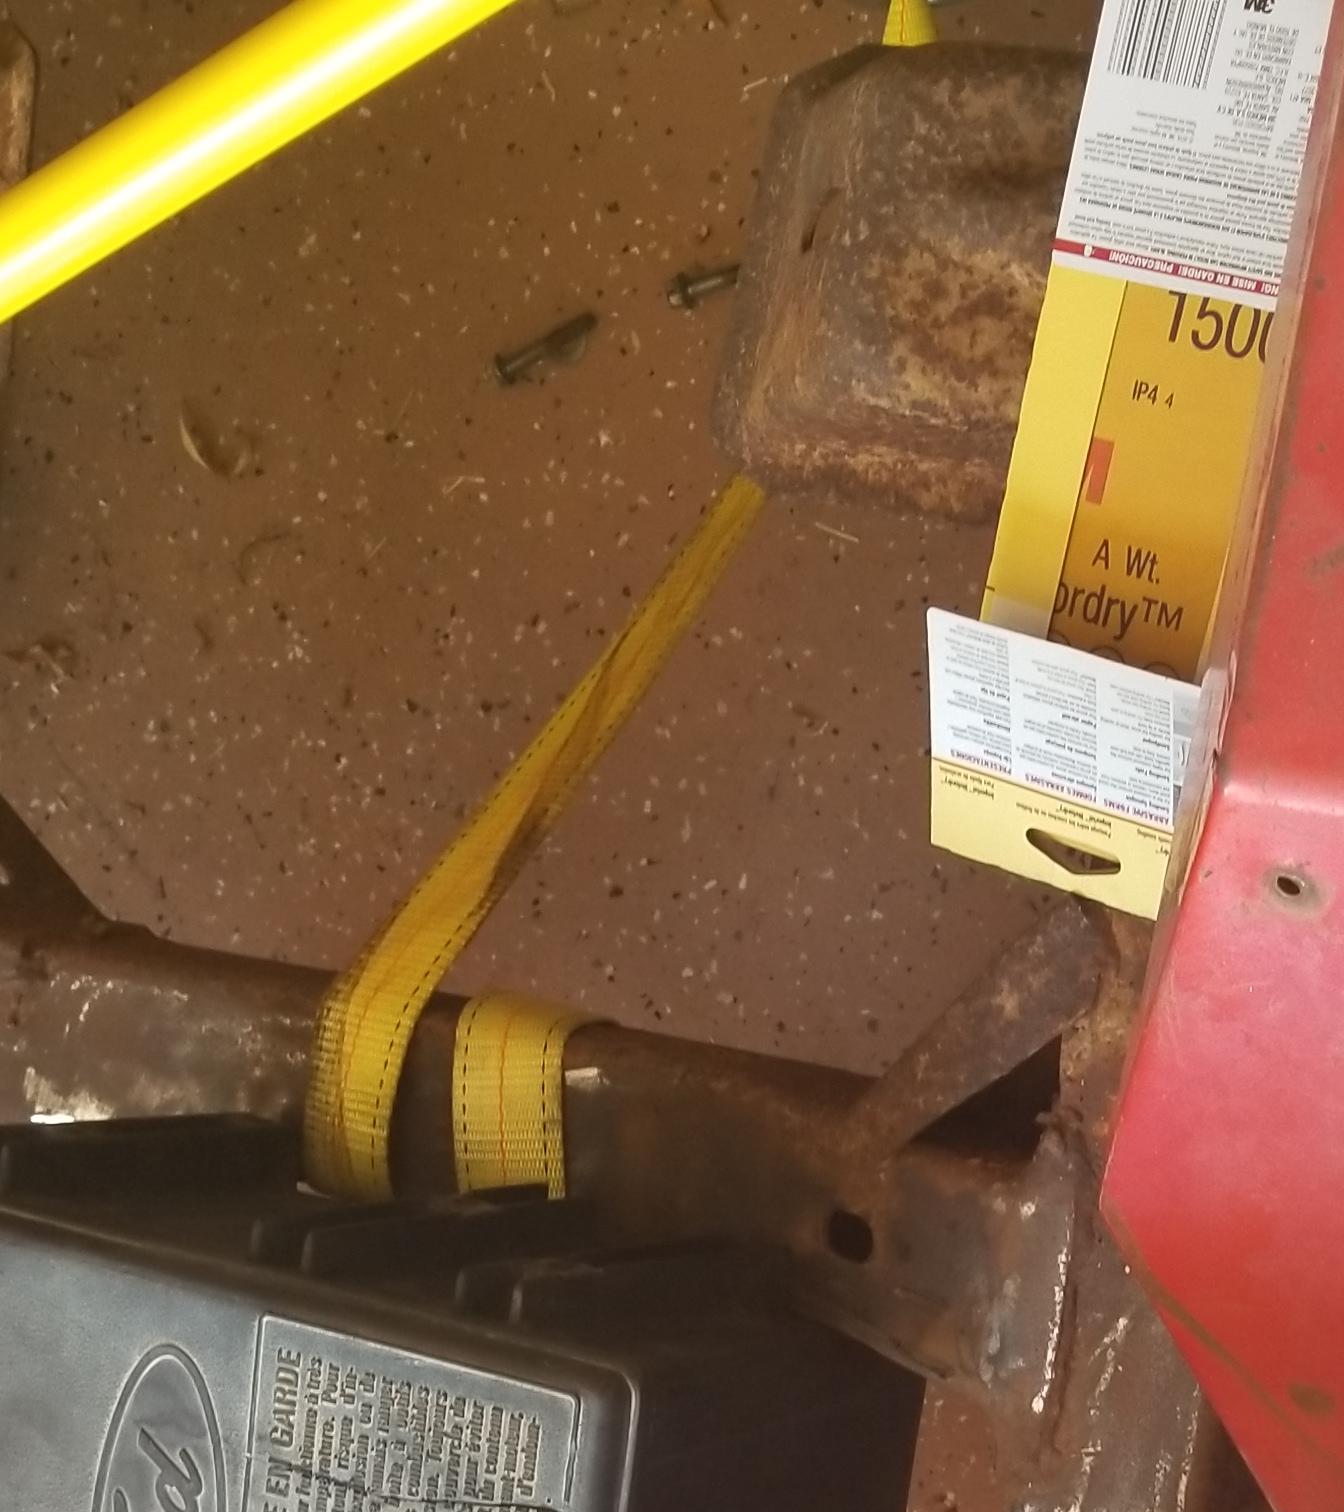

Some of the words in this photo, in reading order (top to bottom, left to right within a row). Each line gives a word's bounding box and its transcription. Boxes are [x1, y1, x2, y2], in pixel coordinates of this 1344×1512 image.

[1091, 538, 1110, 571] A
[1125, 544, 1160, 585] Wt.
[269, 1346, 301, 1449] GARDE
[264, 1454, 291, 1499] EN
